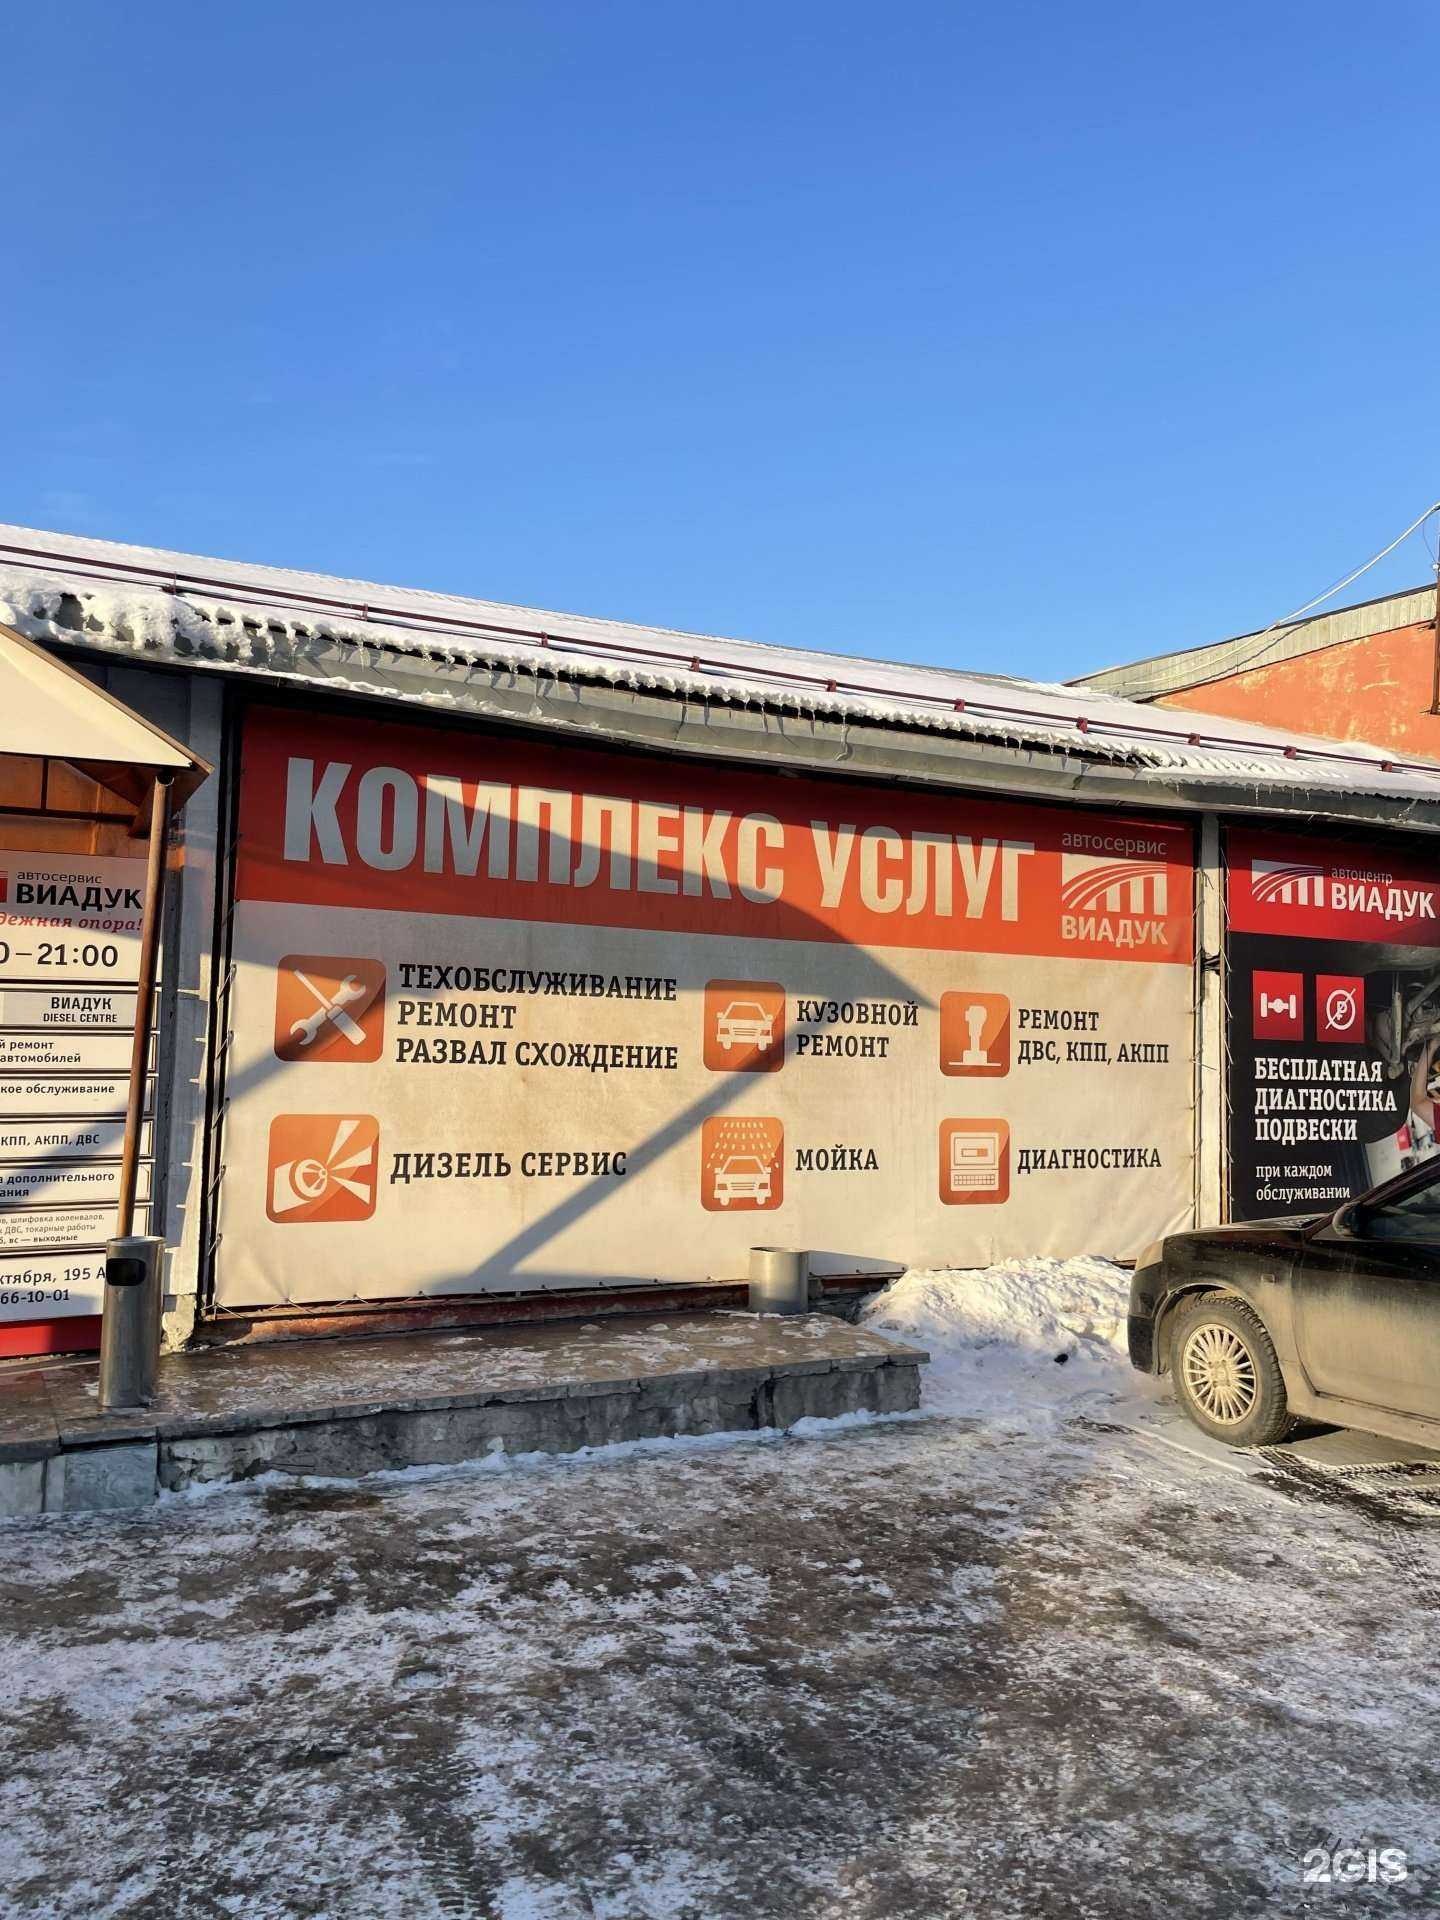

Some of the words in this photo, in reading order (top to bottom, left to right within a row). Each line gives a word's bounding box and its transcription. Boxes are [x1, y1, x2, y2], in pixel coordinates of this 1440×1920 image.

[283, 757, 785, 904] КОМПЛЕКС
[810, 820, 1035, 922] УСЛУГ
[1062, 832, 1167, 856] автосервис
[17, 871, 103, 884] автосервис
[1332, 867, 1393, 887] автоцентр
[16, 883, 143, 911] ВИАДУК
[1331, 882, 1436, 921] ВИАДУК
[78, 917, 143, 935] опора!
[1061, 915, 1168, 948] ВИАДУК
[399, 963, 677, 1001] ТЕХОБСЛУЖИВАНИЕ
[51, 996, 112, 1011] ВИАДУК
[397, 1001, 517, 1030] РЕМОНТ
[796, 996, 919, 1027] КУЗОВНОЙ
[43, 1013, 77, 1023] DIESEL
[80, 1013, 117, 1023] CENTRE
[1018, 1008, 1100, 1032] РЕМОНТ
[10, 1041, 54, 1051] ремонт
[395, 1038, 507, 1065] РАЗВАЛ
[515, 1041, 678, 1073] СХОЖДЕНИЕ
[796, 1033, 890, 1058] РЕМОНТ
[1018, 1040, 1061, 1065] ДВС,
[1066, 1042, 1112, 1065] КПП,
[1117, 1043, 1170, 1064] АКПП
[0, 1053, 81, 1063] автомобилей
[1254, 1057, 1383, 1082] БЕСПЛАТНАЯ
[26, 1083, 115, 1096] обслуживание
[1254, 1087, 1397, 1115] ДИАГНОСТИКА
[34, 1135, 73, 1146] АКПП,
[75, 1134, 100, 1146] ДВС
[1255, 1118, 1358, 1146] ПОДВЕСКИ
[390, 1152, 511, 1184] ДИЗЕЛЬ
[520, 1151, 627, 1178] СЕРВИС
[795, 1143, 879, 1172] МОЙКА
[1018, 1148, 1162, 1174] ДИАГНОСТИКА
[7, 1173, 115, 1185] дополнительного
[1255, 1165, 1281, 1181] при
[1284, 1164, 1332, 1179] каждом
[1256, 1184, 1350, 1204] обслуживании
[66, 1224, 96, 1233] работы
[64, 1267, 91, 1281] 195
[0, 1289, 70, 1304] 66-10-01
